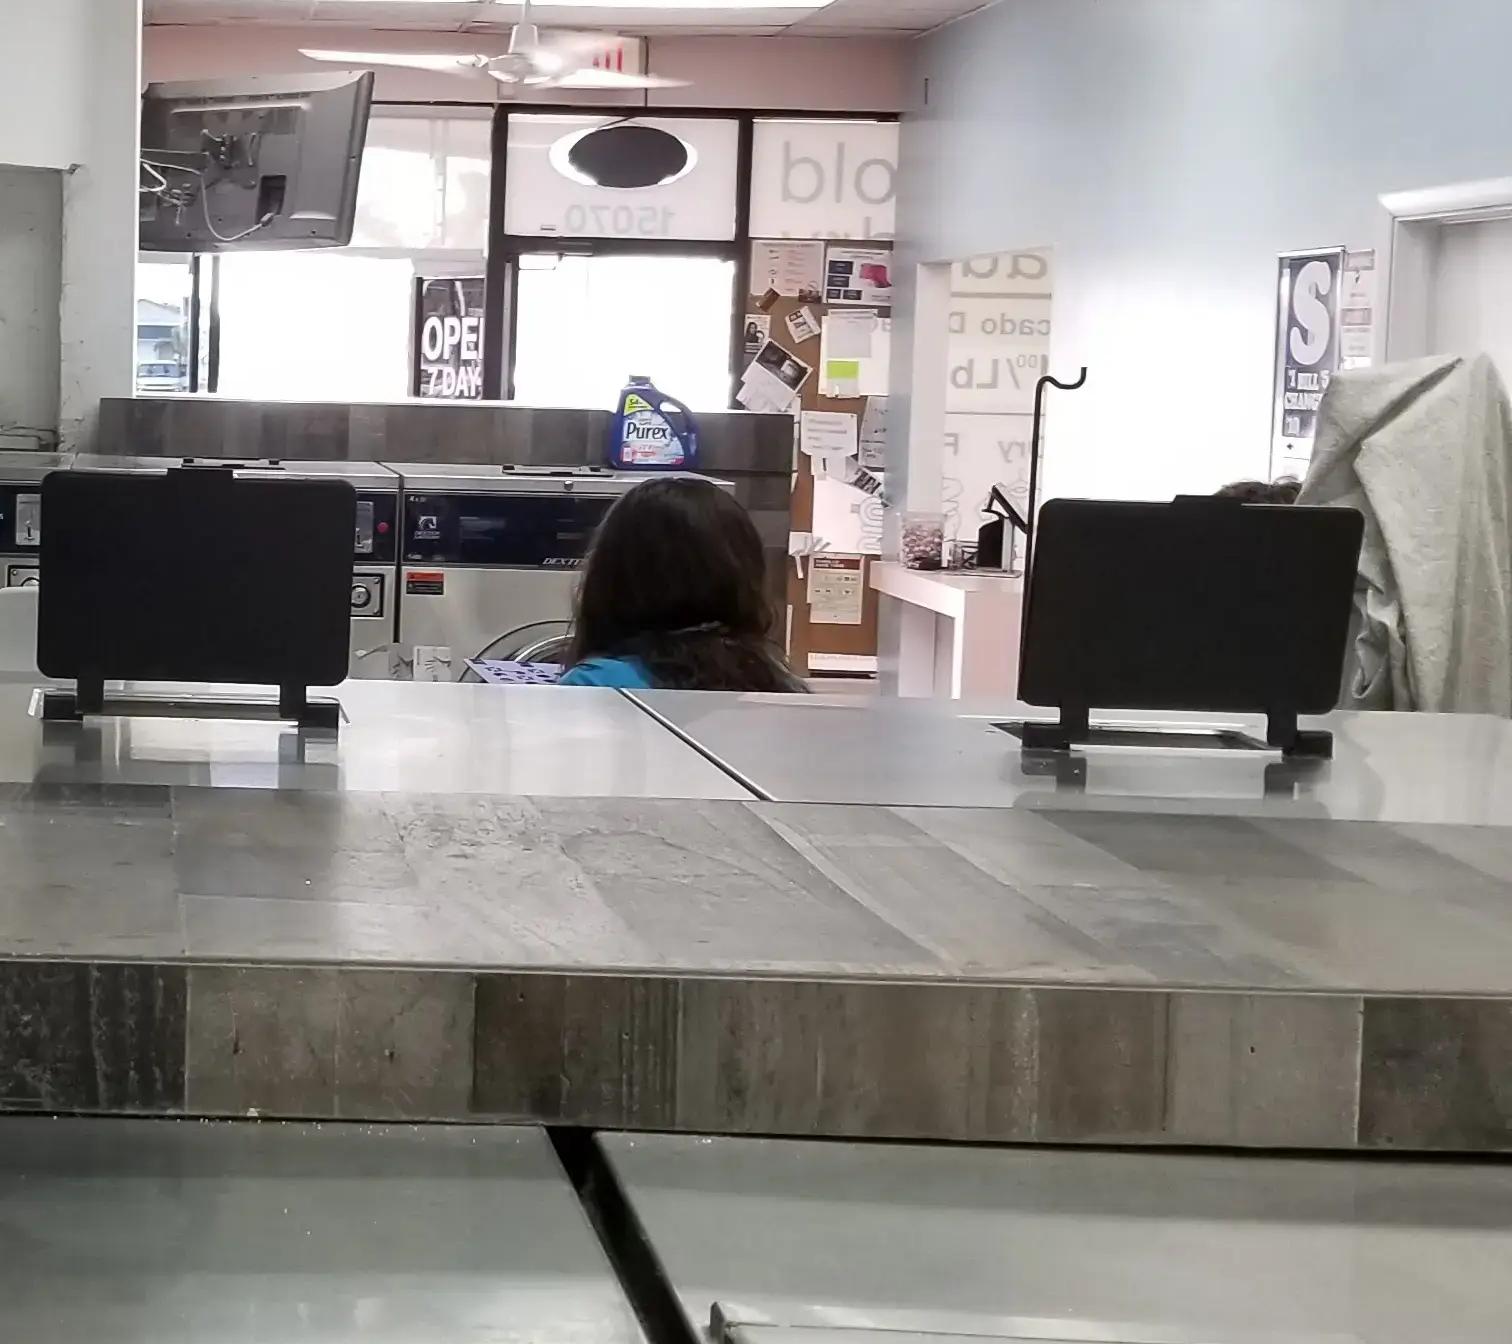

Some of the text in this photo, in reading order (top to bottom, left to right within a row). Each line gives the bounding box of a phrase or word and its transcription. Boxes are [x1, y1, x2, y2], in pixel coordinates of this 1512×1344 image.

[428, 366, 439, 396] 7
[626, 422, 669, 440] Purex
[543, 557, 585, 566] DEXT
